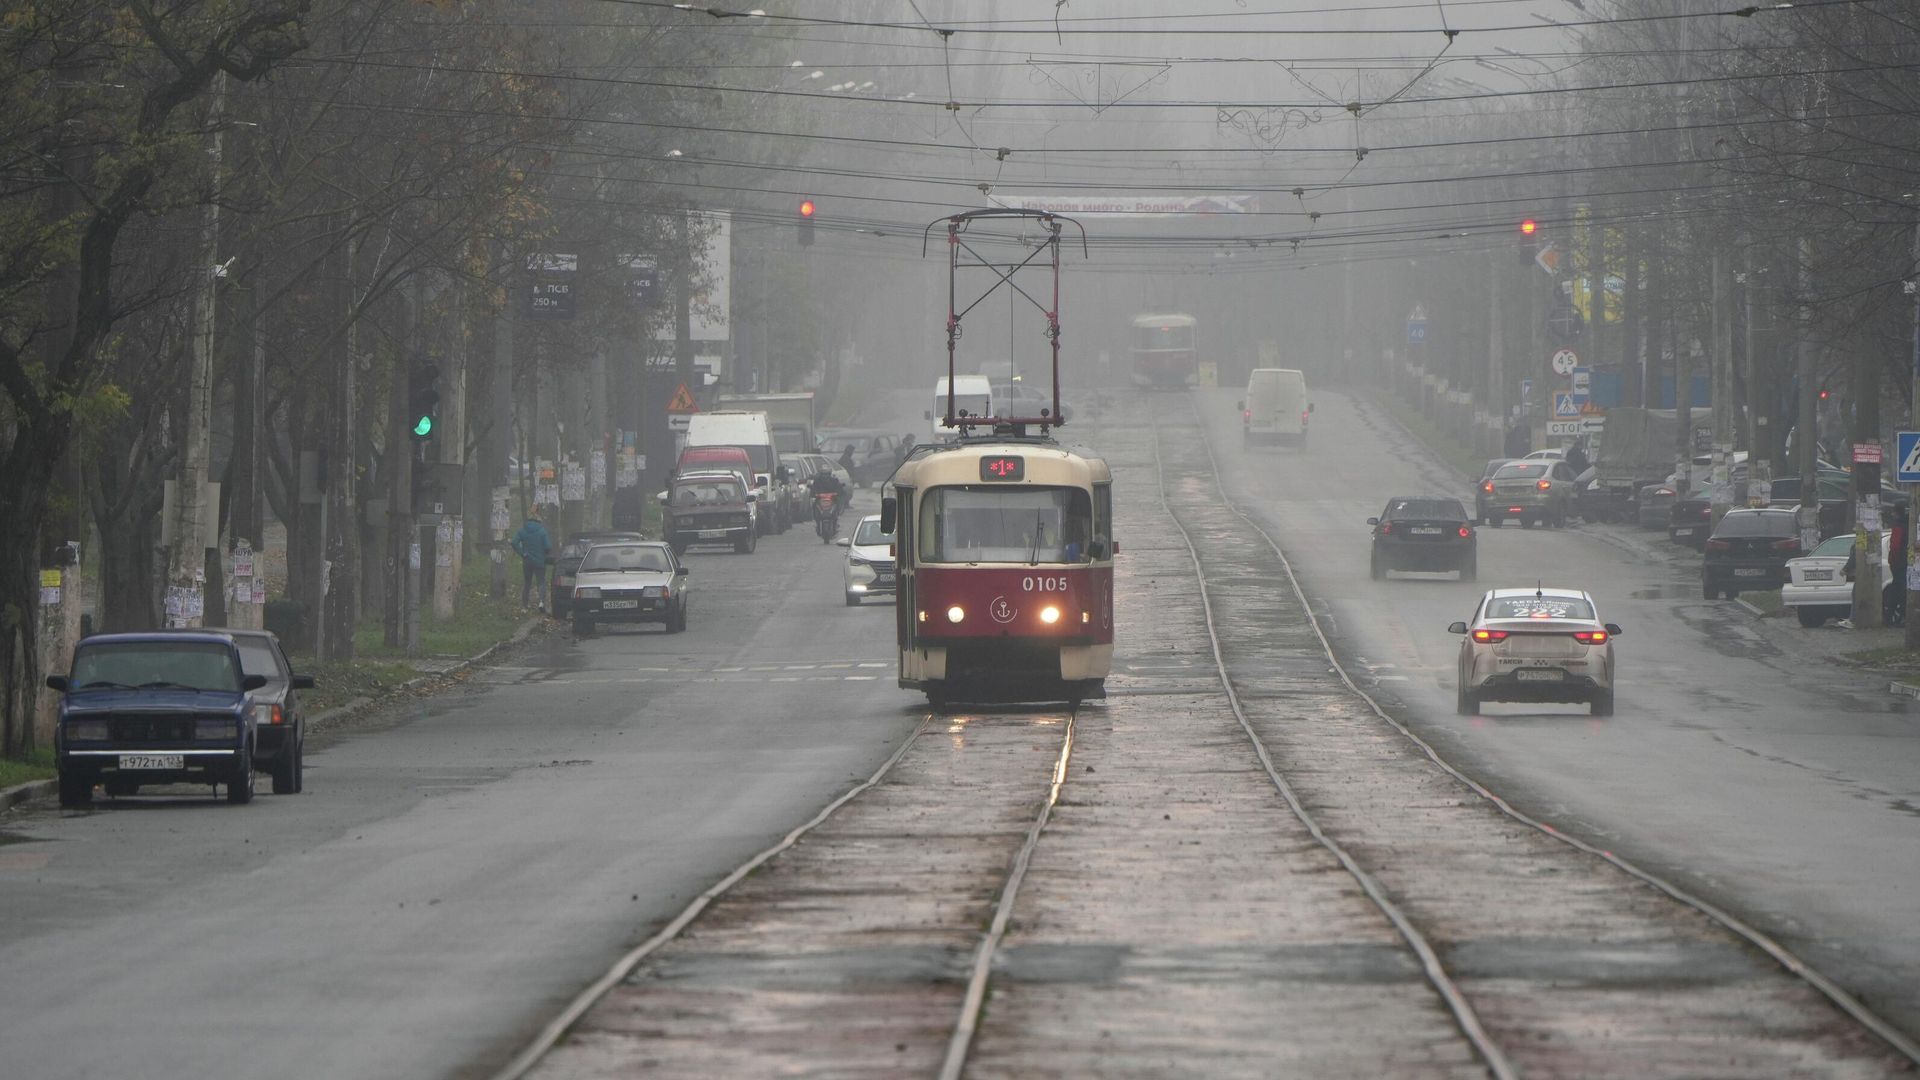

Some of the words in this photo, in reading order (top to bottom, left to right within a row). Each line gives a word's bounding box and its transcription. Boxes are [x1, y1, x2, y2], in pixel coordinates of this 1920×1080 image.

[1083, 203, 1124, 211] много
[547, 284, 569, 293] ПСБ
[1022, 577, 1068, 592] 0105
[1513, 607, 1566, 617] 222
